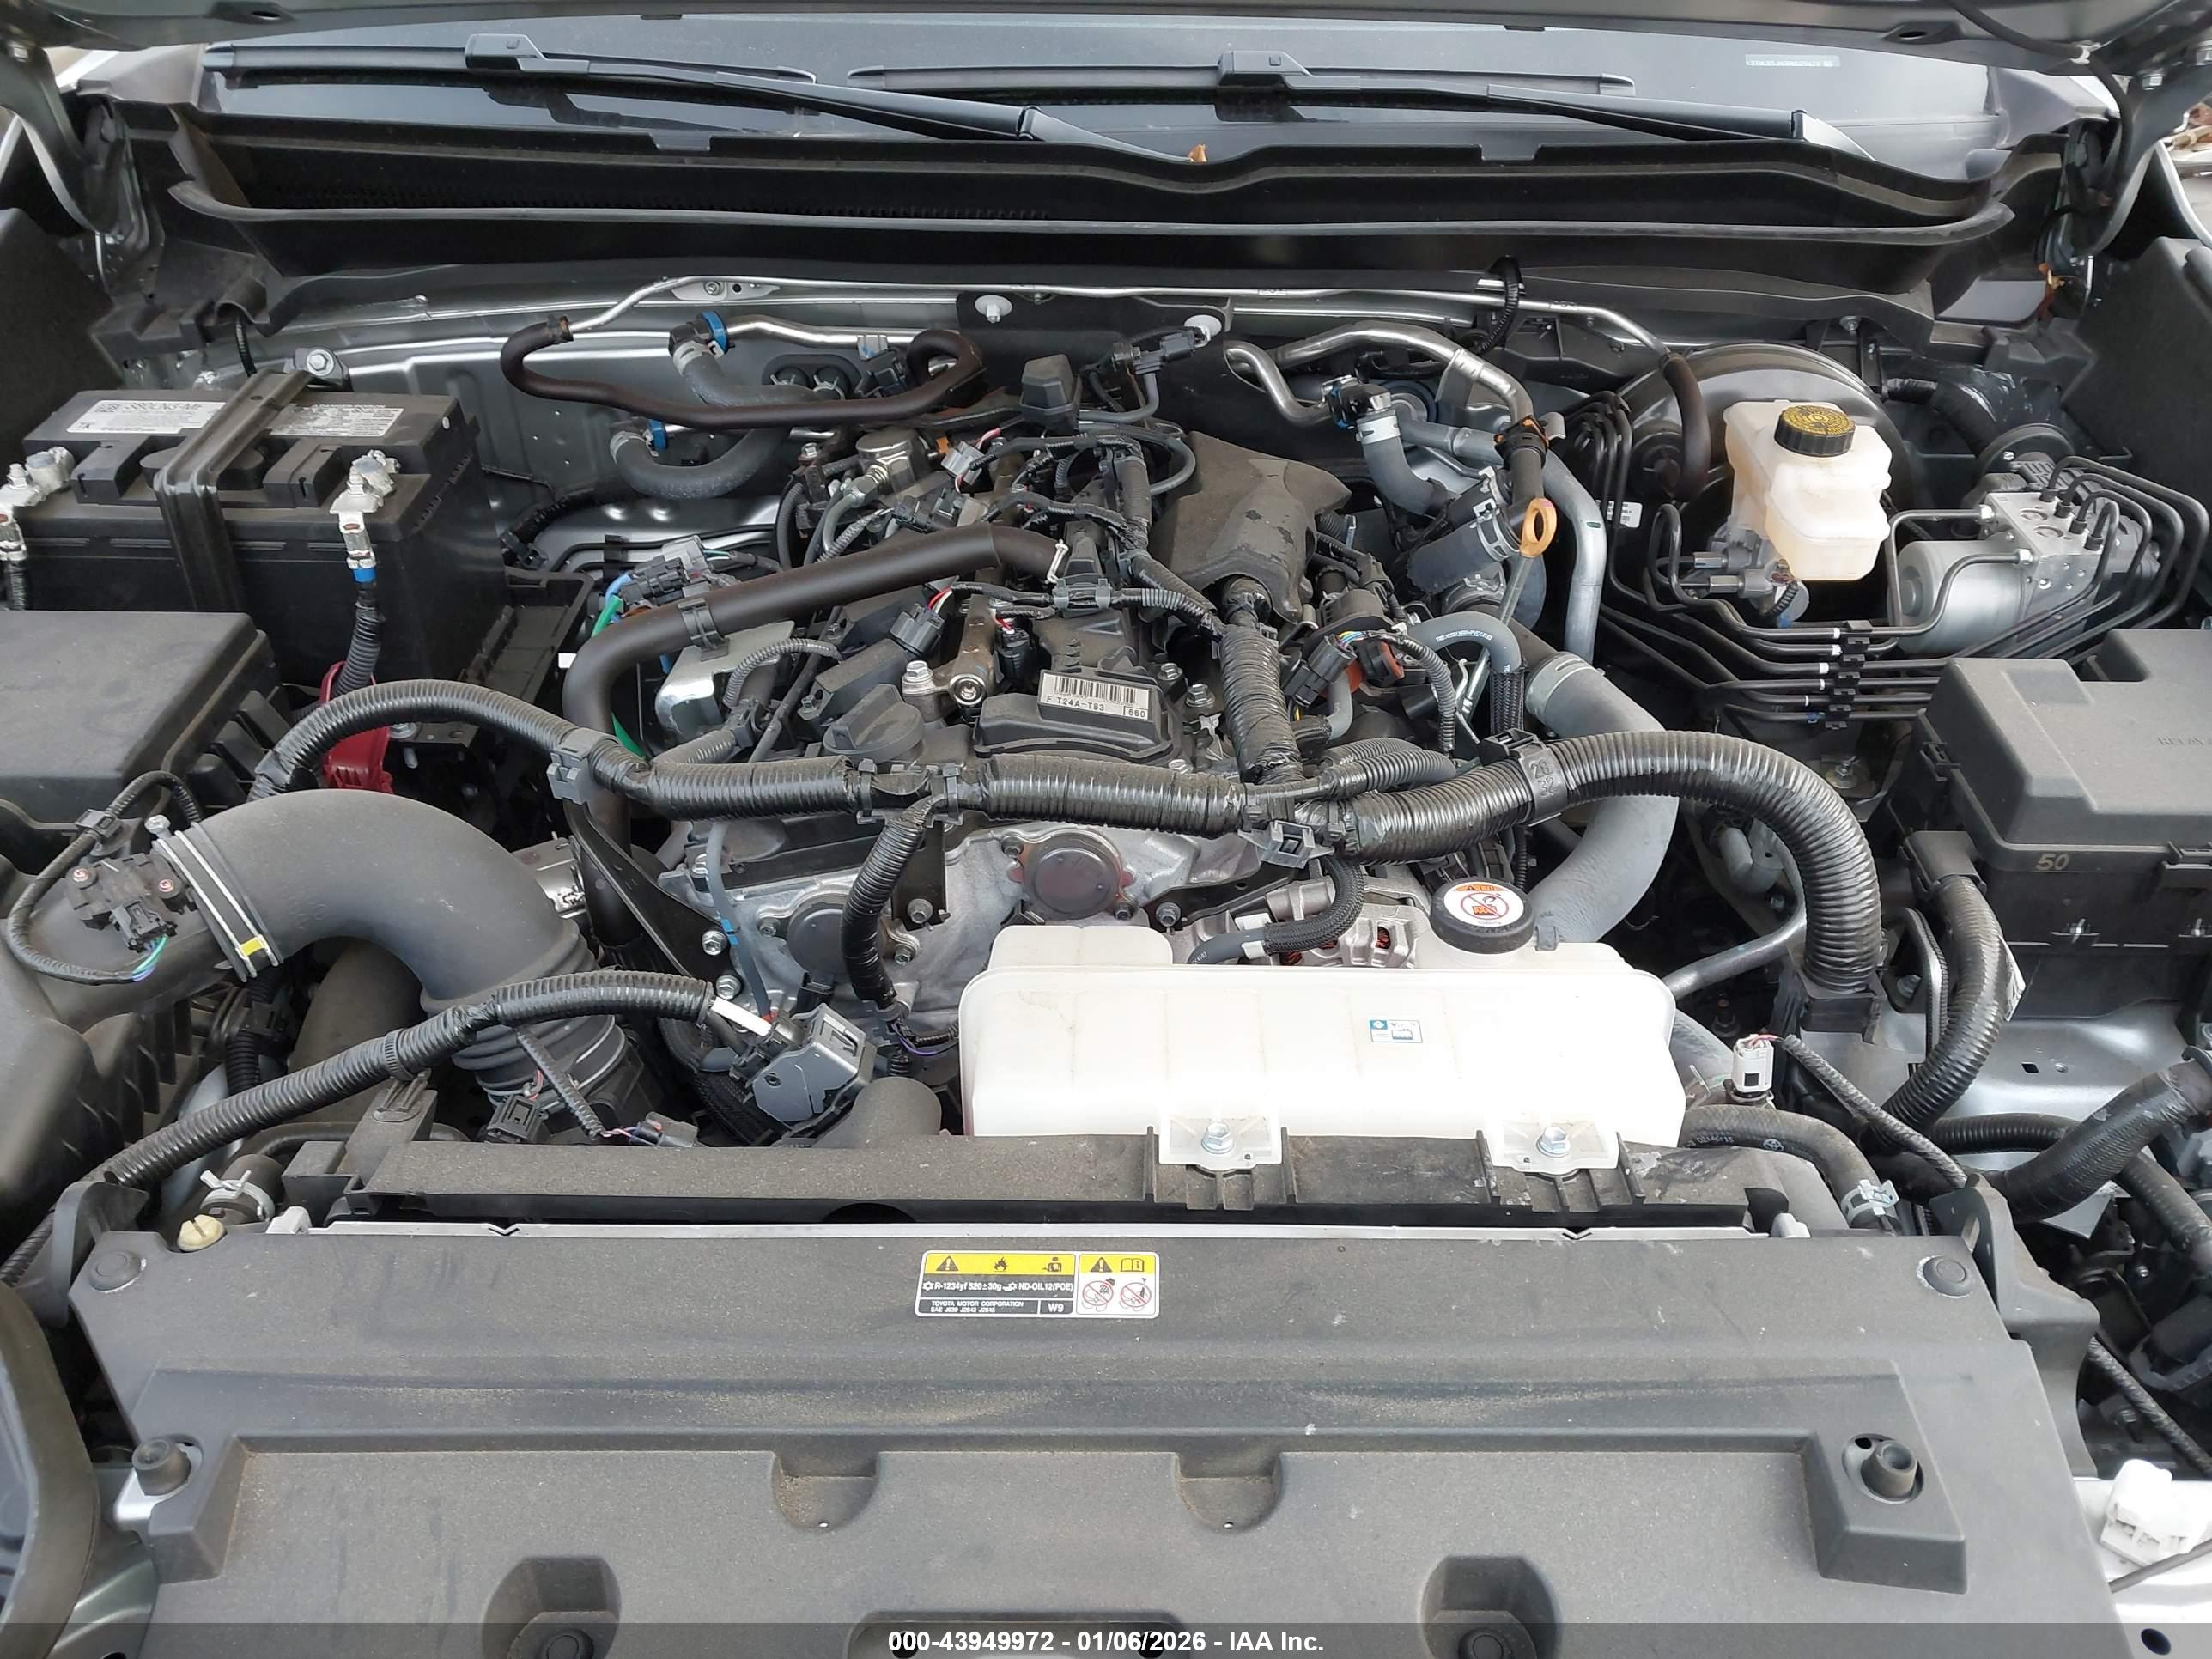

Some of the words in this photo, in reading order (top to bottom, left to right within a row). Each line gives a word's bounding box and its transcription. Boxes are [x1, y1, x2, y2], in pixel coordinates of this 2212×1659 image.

[1128, 708, 1146, 718] 660
[2036, 854, 2069, 871] 50
[934, 1281, 967, 1292] R-1234yf
[1018, 1281, 1073, 1292] ND-OIL12(POE)
[1048, 1302, 1064, 1312] W9
